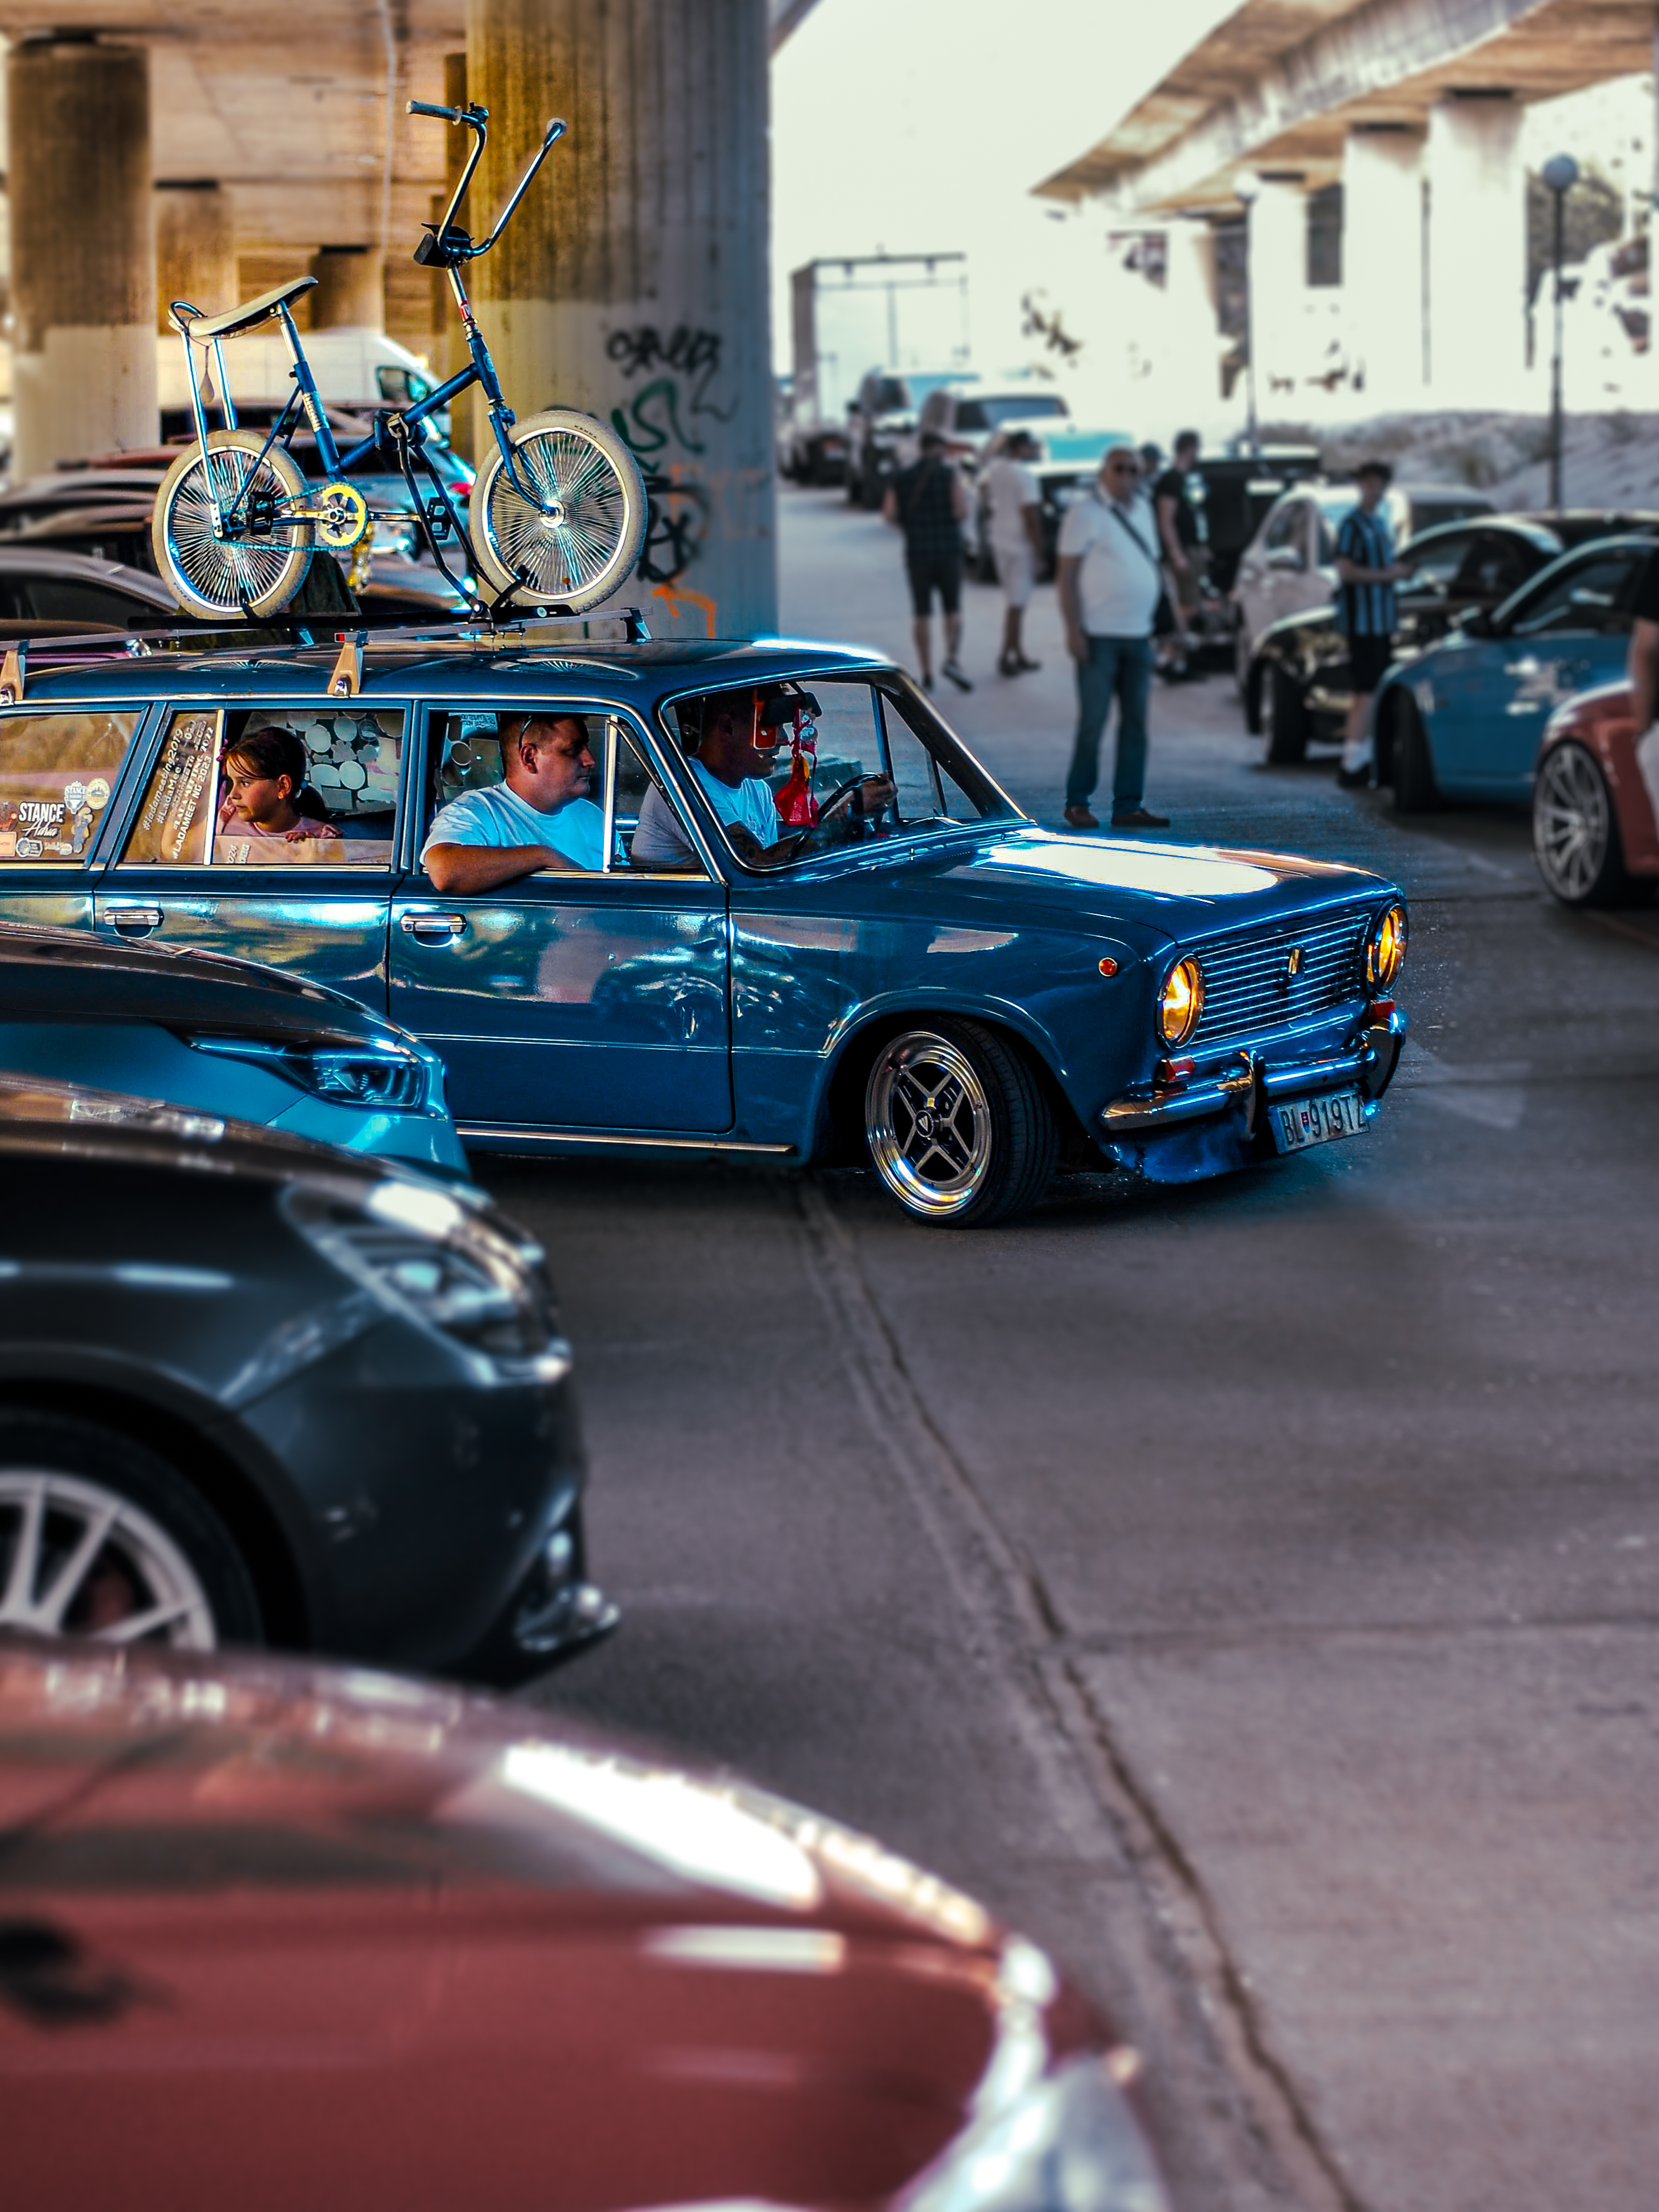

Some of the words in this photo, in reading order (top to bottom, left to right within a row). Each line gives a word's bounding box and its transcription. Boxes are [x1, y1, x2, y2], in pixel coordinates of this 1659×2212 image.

[574, 425, 597, 439] KENDA
[200, 727, 214, 752] 2022
[142, 728, 184, 831] #ladameeting2019
[18, 802, 65, 823] STANCE
[171, 798, 197, 860] #LADAMEET
[193, 784, 203, 799] NG
[198, 755, 213, 783] 2023
[1280, 1109, 1305, 1145] BL
[1309, 1092, 1366, 1137] 919TZ
